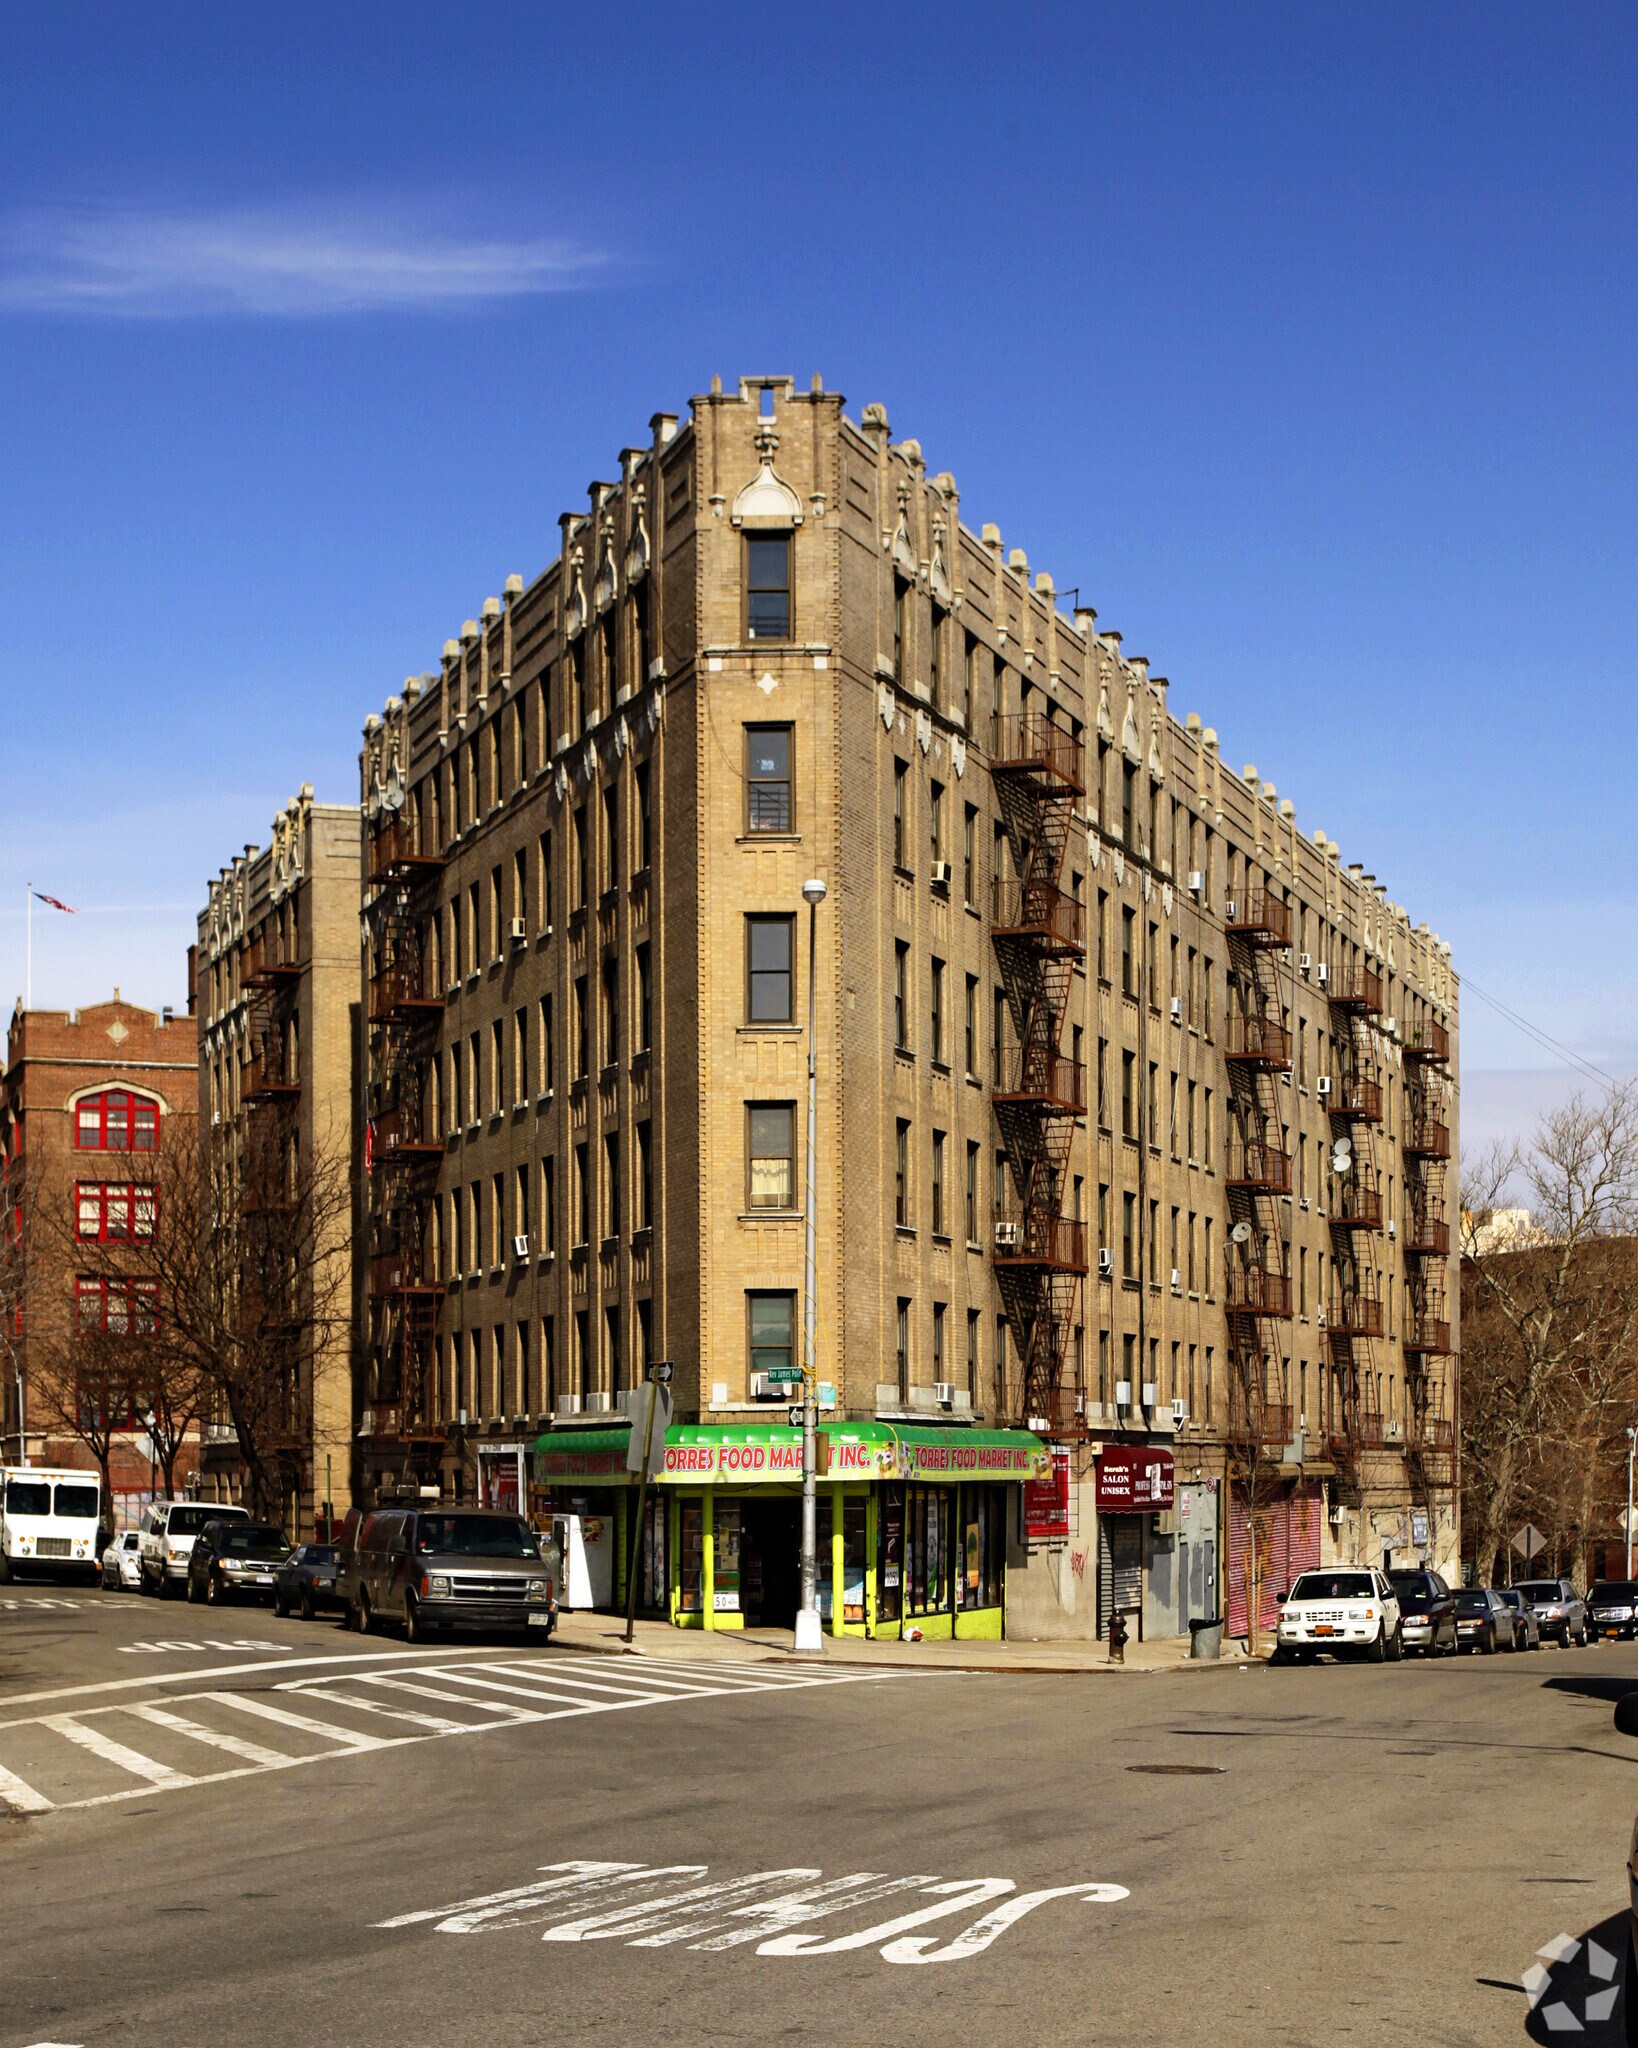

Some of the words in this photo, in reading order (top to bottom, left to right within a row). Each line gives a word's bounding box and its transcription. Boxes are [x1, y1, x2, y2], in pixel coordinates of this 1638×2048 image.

[718, 1446, 765, 1470] FOOD
[769, 1446, 836, 1468] MART
[839, 1444, 871, 1468] INC.
[914, 1446, 949, 1469] TORRES
[951, 1446, 977, 1469] FOOD
[978, 1447, 1012, 1470] MARKET
[1013, 1449, 1030, 1470] INC.
[1103, 1475, 1129, 1483] SALON
[1101, 1487, 1130, 1495] UNISEX
[117, 1640, 293, 1653] STOP
[365, 1860, 1130, 1964] SCHOOL
